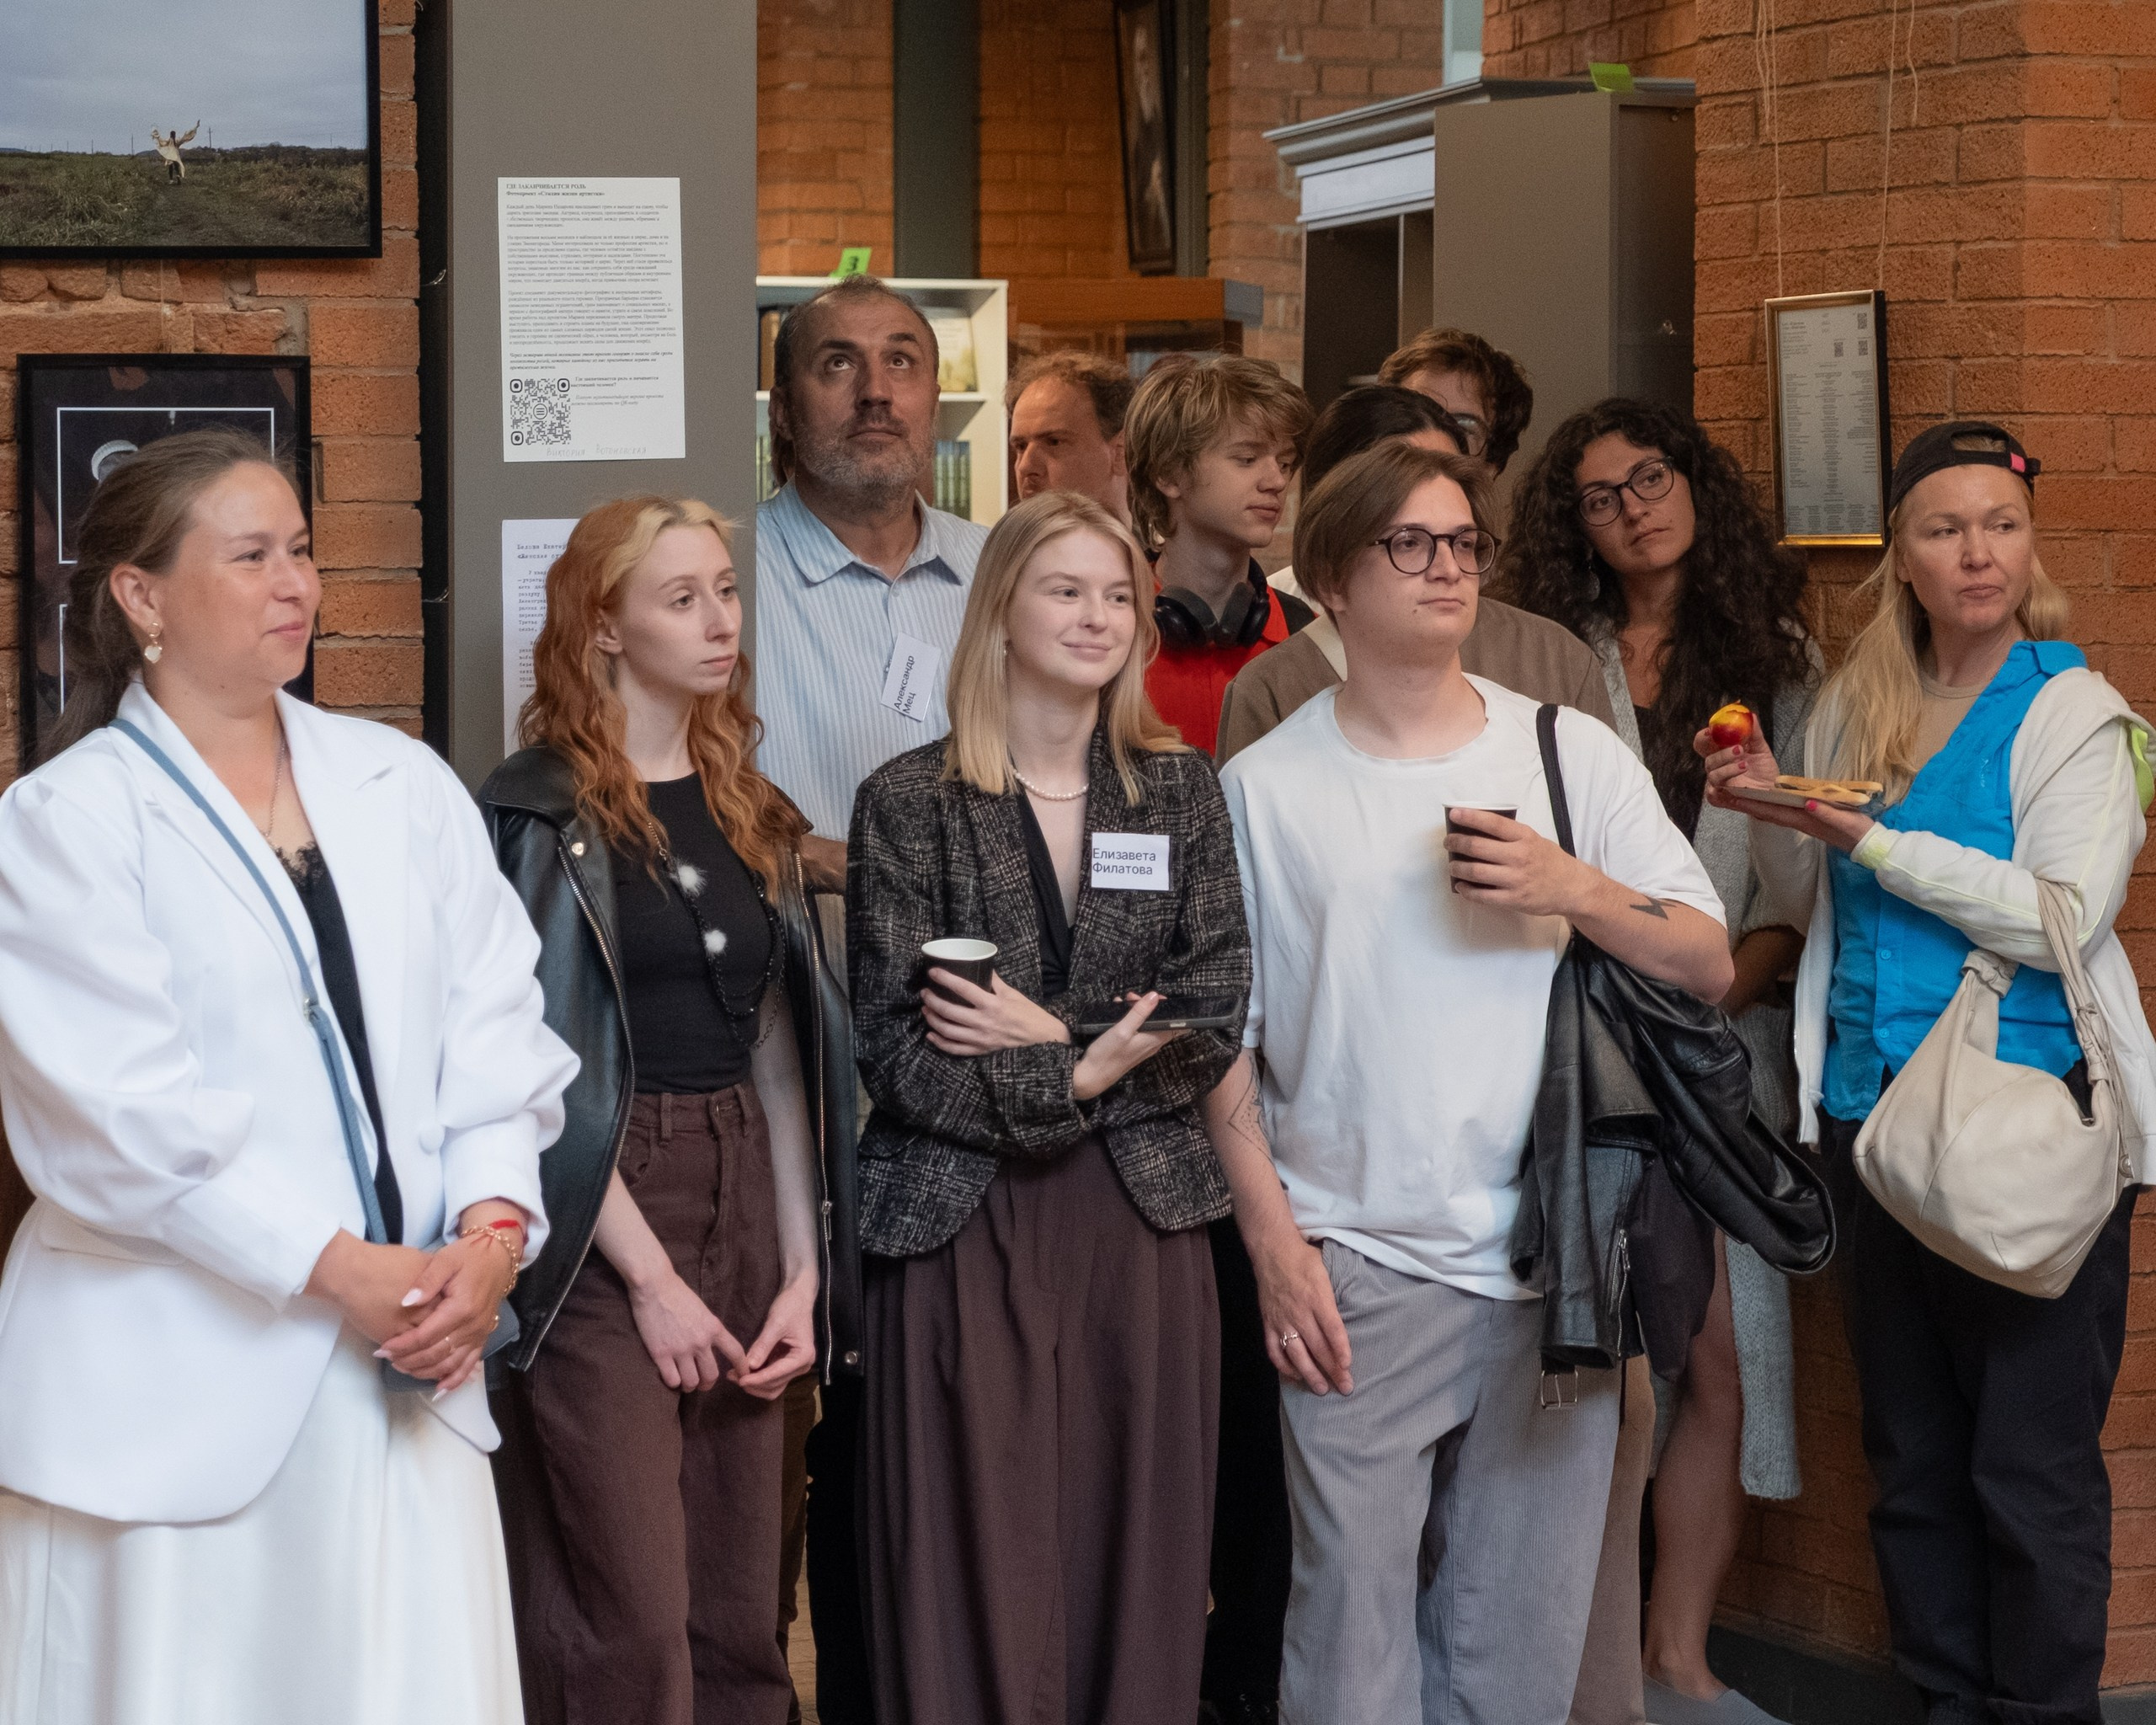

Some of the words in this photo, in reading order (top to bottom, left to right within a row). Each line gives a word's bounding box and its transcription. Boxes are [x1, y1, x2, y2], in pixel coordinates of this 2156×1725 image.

[894, 655, 915, 710] Александр
[902, 692, 916, 714] Мец
[1093, 847, 1156, 862] Елизавета
[1093, 862, 1153, 875] Филатова
